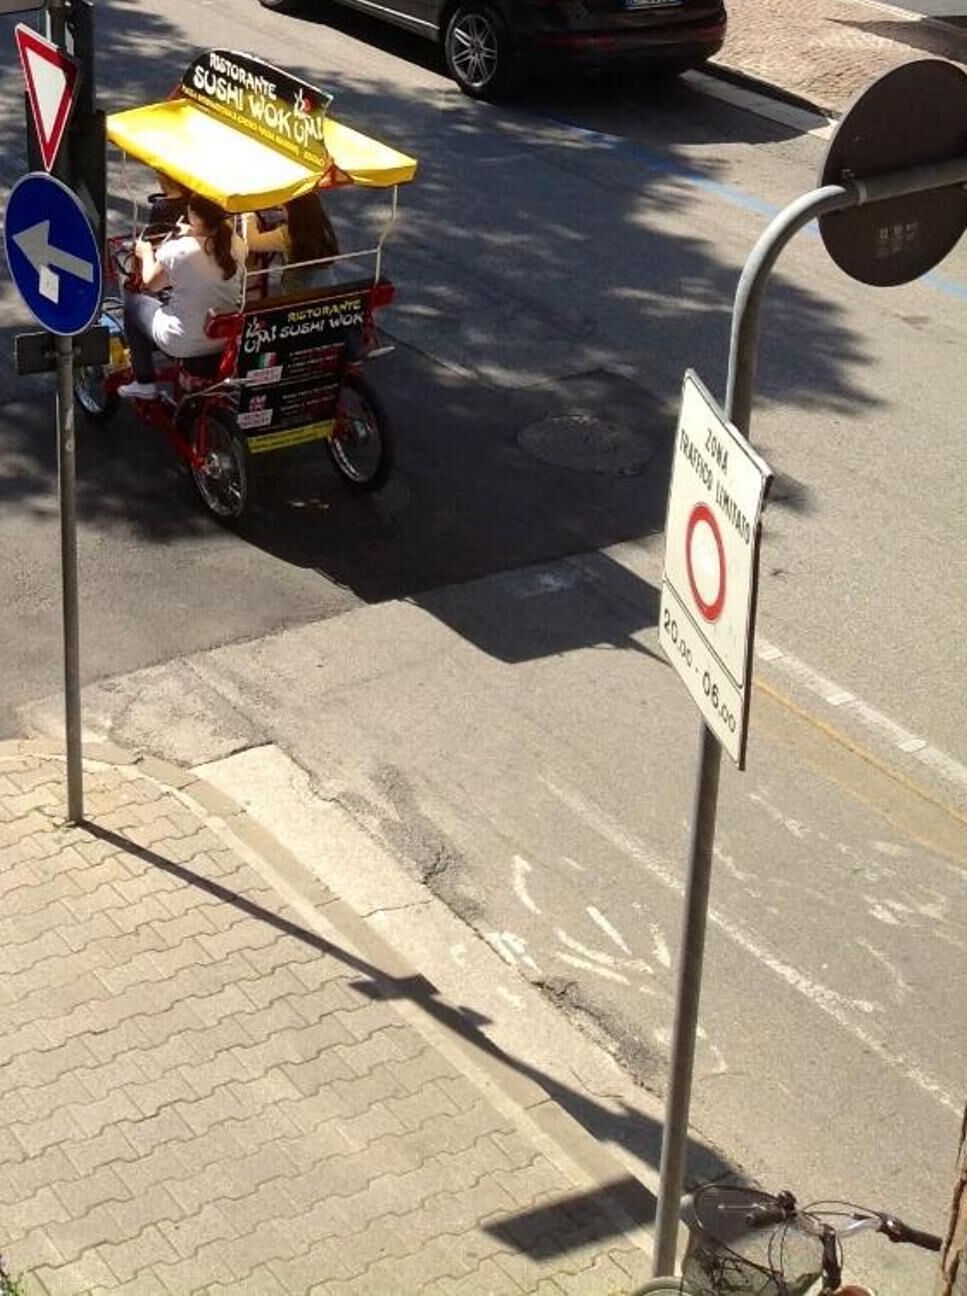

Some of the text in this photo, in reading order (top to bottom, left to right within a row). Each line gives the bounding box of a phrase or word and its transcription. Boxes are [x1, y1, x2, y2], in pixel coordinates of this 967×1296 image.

[210, 53, 277, 101] RISTORANTE
[193, 65, 244, 111] SUSHI
[248, 94, 294, 139] WOK
[294, 115, 325, 147] UMI
[244, 313, 364, 354] UMI SUSHI WOK
[287, 299, 362, 323] RISTORANTE
[705, 428, 729, 476] ZONA
[679, 428, 751, 545] TRAFFICO LIMITATO
[663, 608, 693, 668] 20.00
